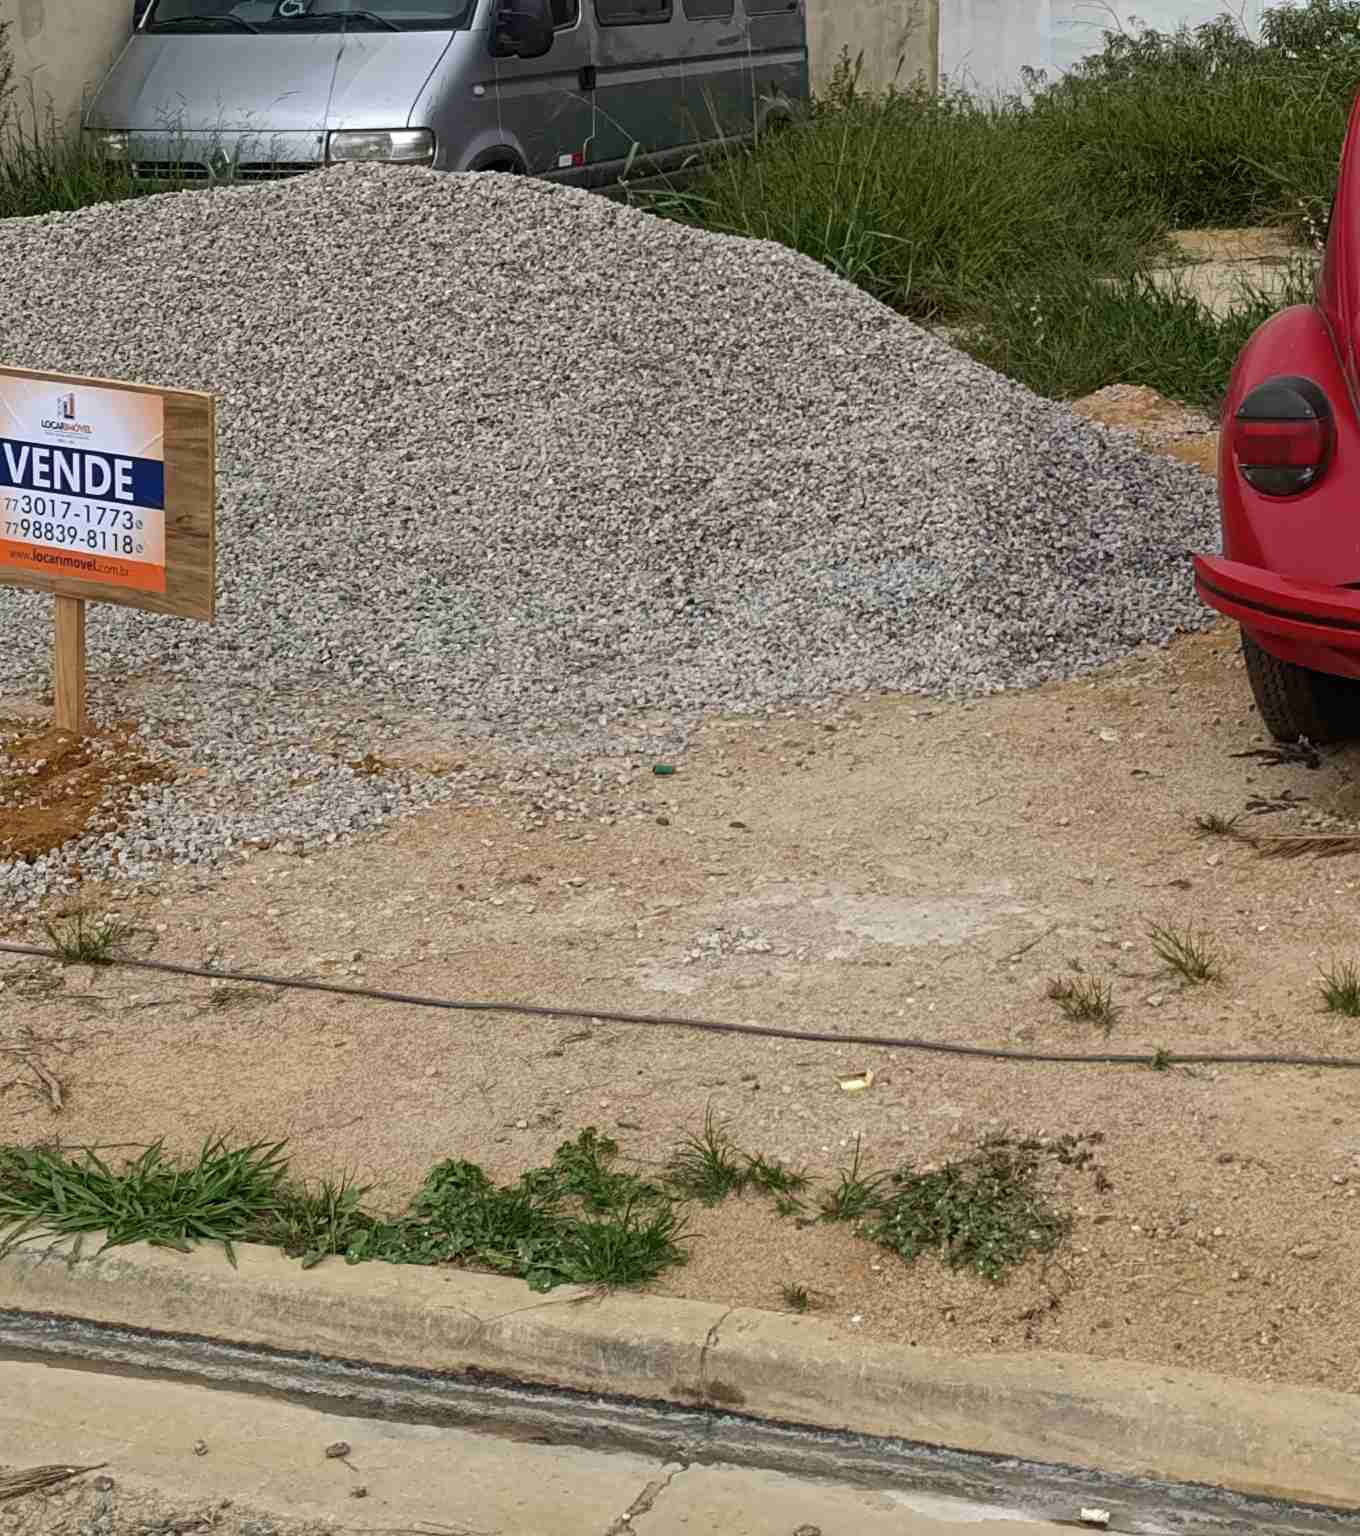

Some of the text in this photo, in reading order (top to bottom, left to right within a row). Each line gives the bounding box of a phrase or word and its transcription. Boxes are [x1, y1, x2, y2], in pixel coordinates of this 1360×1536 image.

[3, 442, 135, 501] VENDE
[21, 495, 134, 530] 3017-1773
[20, 518, 133, 554] 98839-8118
